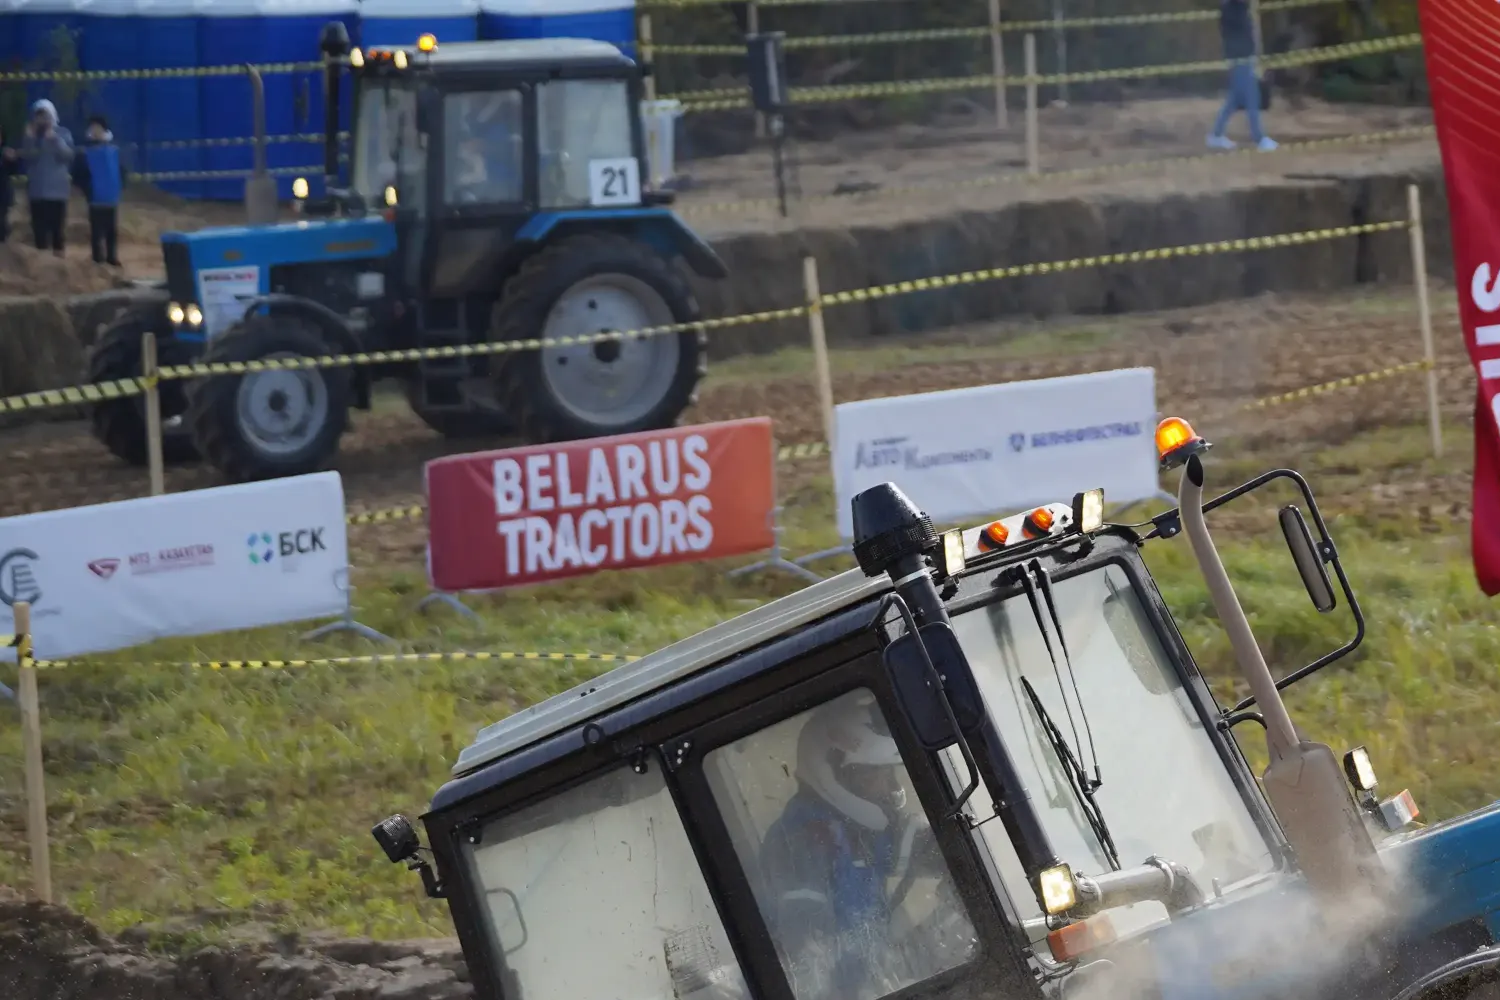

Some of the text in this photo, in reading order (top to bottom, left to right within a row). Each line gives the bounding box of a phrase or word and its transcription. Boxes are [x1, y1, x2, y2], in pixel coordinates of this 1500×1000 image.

[602, 166, 628, 197] 21
[493, 434, 713, 517] BELARUS
[279, 526, 327, 556] БСК
[498, 494, 714, 578] TRACTORS
